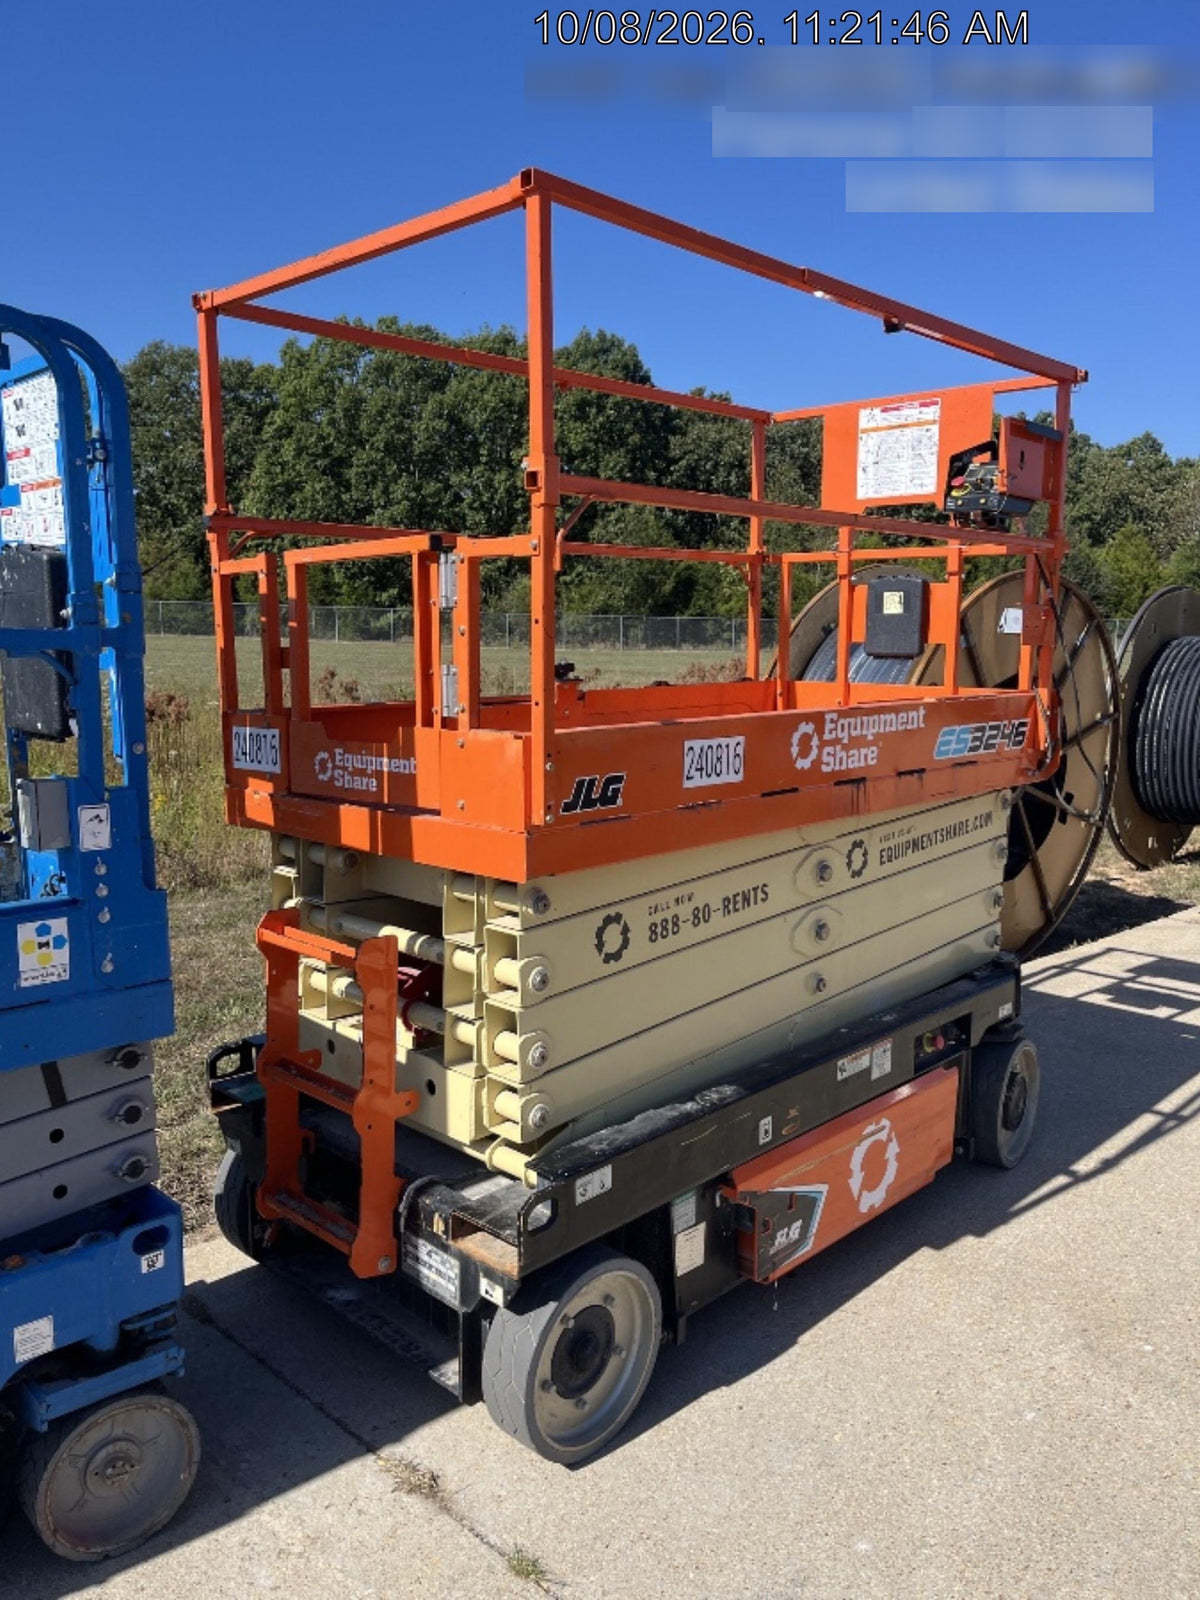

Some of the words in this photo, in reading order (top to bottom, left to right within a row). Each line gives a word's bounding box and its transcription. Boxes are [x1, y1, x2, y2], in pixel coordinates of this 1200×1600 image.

[823, 706, 926, 744] Equipment
[933, 718, 1031, 760] ES3246
[334, 748, 416, 774] Equipment
[685, 741, 742, 781] 240816
[820, 745, 879, 773] Share
[333, 769, 378, 792] Share
[560, 772, 625, 814] JLG
[879, 810, 994, 866] EQUIPMENTSHARE.COM
[648, 883, 769, 943] 888-80-RENTS
